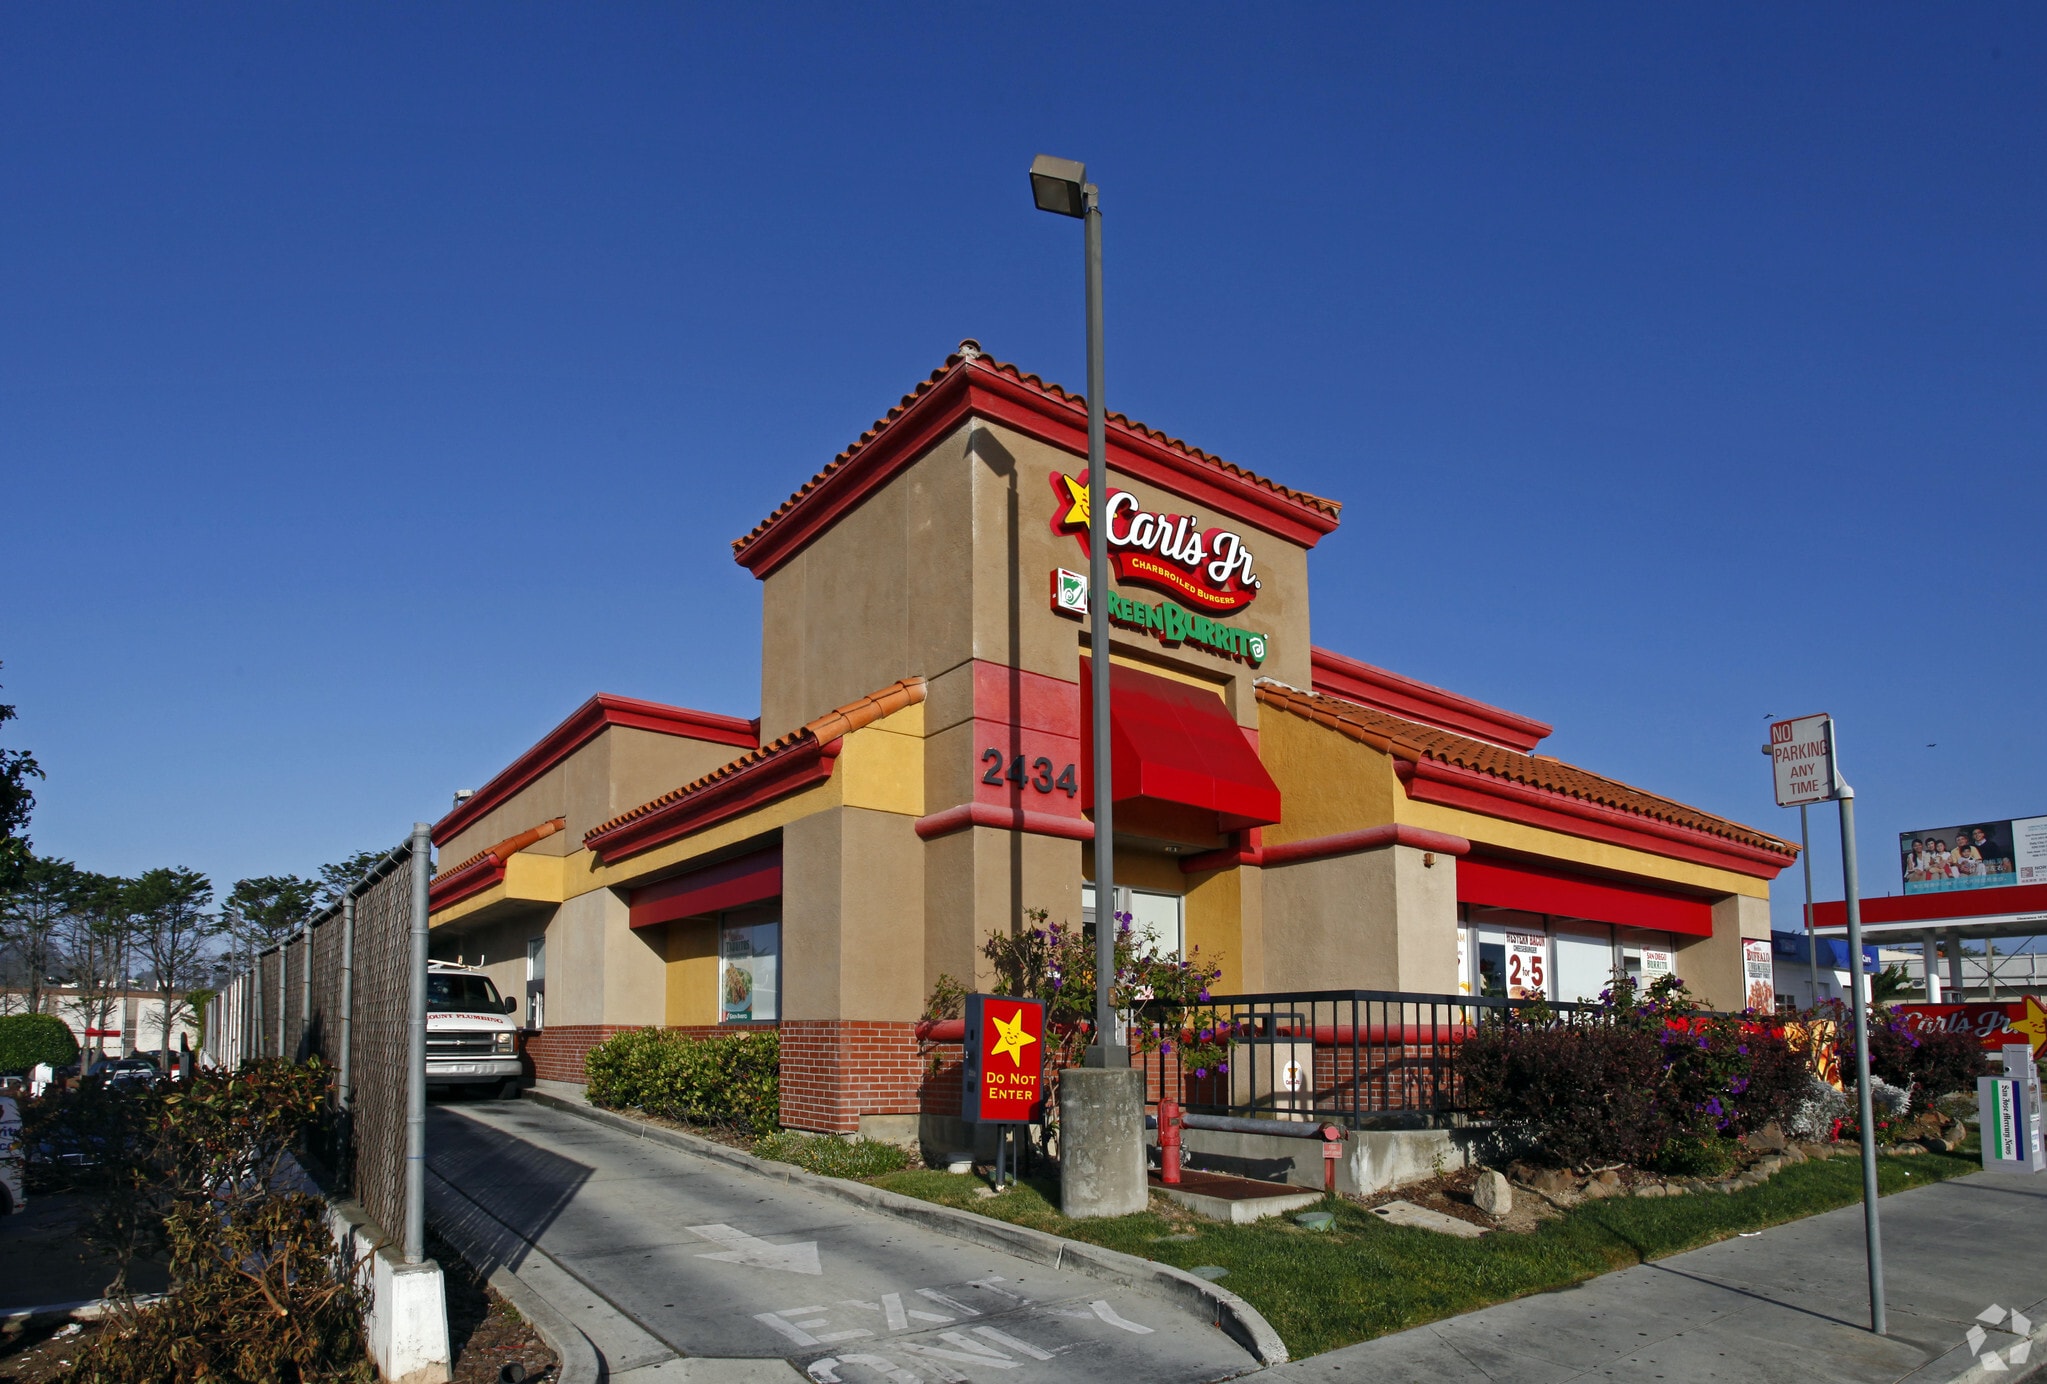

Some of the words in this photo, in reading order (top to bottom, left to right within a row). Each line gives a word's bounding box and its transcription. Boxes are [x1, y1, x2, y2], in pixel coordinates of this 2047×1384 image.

[1106, 491, 1207, 566] Carl's
[1207, 531, 1261, 589] Jr.
[1132, 558, 1195, 593] CHARBROILED
[1197, 590, 1235, 604] BURGERS
[1772, 724, 1791, 743] NO
[1775, 740, 1828, 763] PARKING
[981, 747, 1078, 798] 2434
[1790, 763, 1815, 778] ANY
[1789, 779, 1819, 795] TIME
[1509, 953, 1522, 986] 2
[1522, 967, 1530, 976] for
[1974, 1011, 2018, 1037] Jr.
[986, 1072, 1004, 1083] DO
[1010, 1073, 1036, 1085] NOT
[989, 1088, 1032, 1100] ENTER
[753, 1276, 1032, 1347] EXIT
